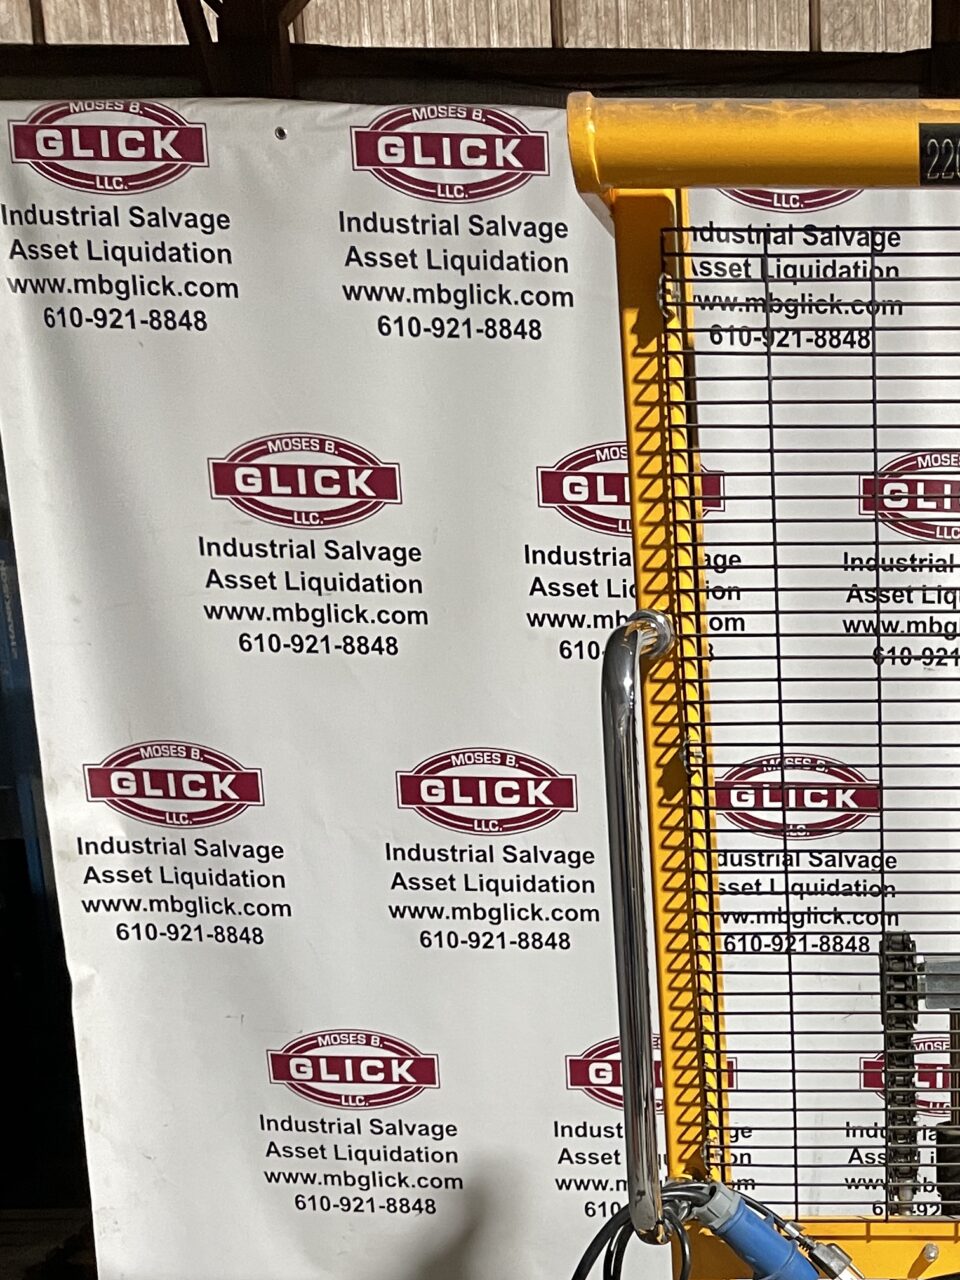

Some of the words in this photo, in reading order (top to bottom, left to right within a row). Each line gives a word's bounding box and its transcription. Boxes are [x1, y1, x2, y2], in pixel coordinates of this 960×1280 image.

[68, 98, 124, 114] MOSES
[411, 105, 467, 121] MOSES
[34, 129, 182, 159] GLICK
[376, 136, 523, 168] GLICK
[96, 176, 128, 189] LLC.
[437, 184, 469, 197] LLC.
[773, 194, 804, 207] LLC.
[1, 204, 119, 227] Industrial
[129, 206, 230, 235] Salvage
[339, 211, 459, 235] Industrial
[469, 214, 568, 243] Salvage
[9, 239, 80, 261] Asset
[87, 239, 232, 267] Liquidation
[345, 246, 418, 269] Asset
[427, 249, 568, 276] Liquidation
[6, 274, 239, 301] www.mbglick.com
[342, 283, 573, 310] www.mbglick.com
[44, 307, 207, 331] 610-921-8848
[378, 315, 542, 340] 610-921-8848
[266, 439, 320, 453] MOSES
[233, 467, 376, 497] GLICK
[293, 511, 324, 524] LLC.
[199, 536, 315, 559] Industrial
[324, 540, 421, 567] Salvage
[206, 569, 277, 590] Asset
[285, 571, 422, 596] Liquidation
[203, 603, 428, 628] www.mbglick.com
[239, 633, 398, 655] 610-921-8848
[138, 746, 187, 759] MOSES
[450, 753, 501, 767] MOSES
[109, 772, 239, 799] GLICK
[419, 780, 553, 805] GLICK
[730, 785, 860, 810] GLICK
[165, 812, 193, 824] LLC.
[474, 819, 503, 830] LLC.
[77, 836, 186, 856] Industrial
[194, 838, 283, 863] Salvage
[386, 843, 494, 863] Industrial
[503, 845, 594, 869] Salvage
[809, 849, 897, 873] Salvage
[84, 866, 153, 884] Asset
[160, 866, 285, 890] Liquidation
[391, 872, 456, 891] Asset
[464, 874, 594, 897] Liquidation
[81, 895, 291, 918] www.mbglick.com
[388, 903, 599, 925] www.mbglick.com
[116, 923, 264, 944] 610-921-8848
[420, 930, 570, 950] 610-921-8848
[724, 934, 869, 954] 610-921-8848
[317, 1034, 366, 1047] MOSES
[287, 1059, 417, 1083] GLICK
[341, 1095, 369, 1105] LLC.
[260, 1114, 361, 1135] Industrial
[370, 1119, 457, 1141] Salvage
[266, 1141, 327, 1159] Asset
[334, 1144, 458, 1165] Liquidation
[264, 1170, 463, 1191] www.mbglick.com
[295, 1194, 436, 1215] 610-921-8848
